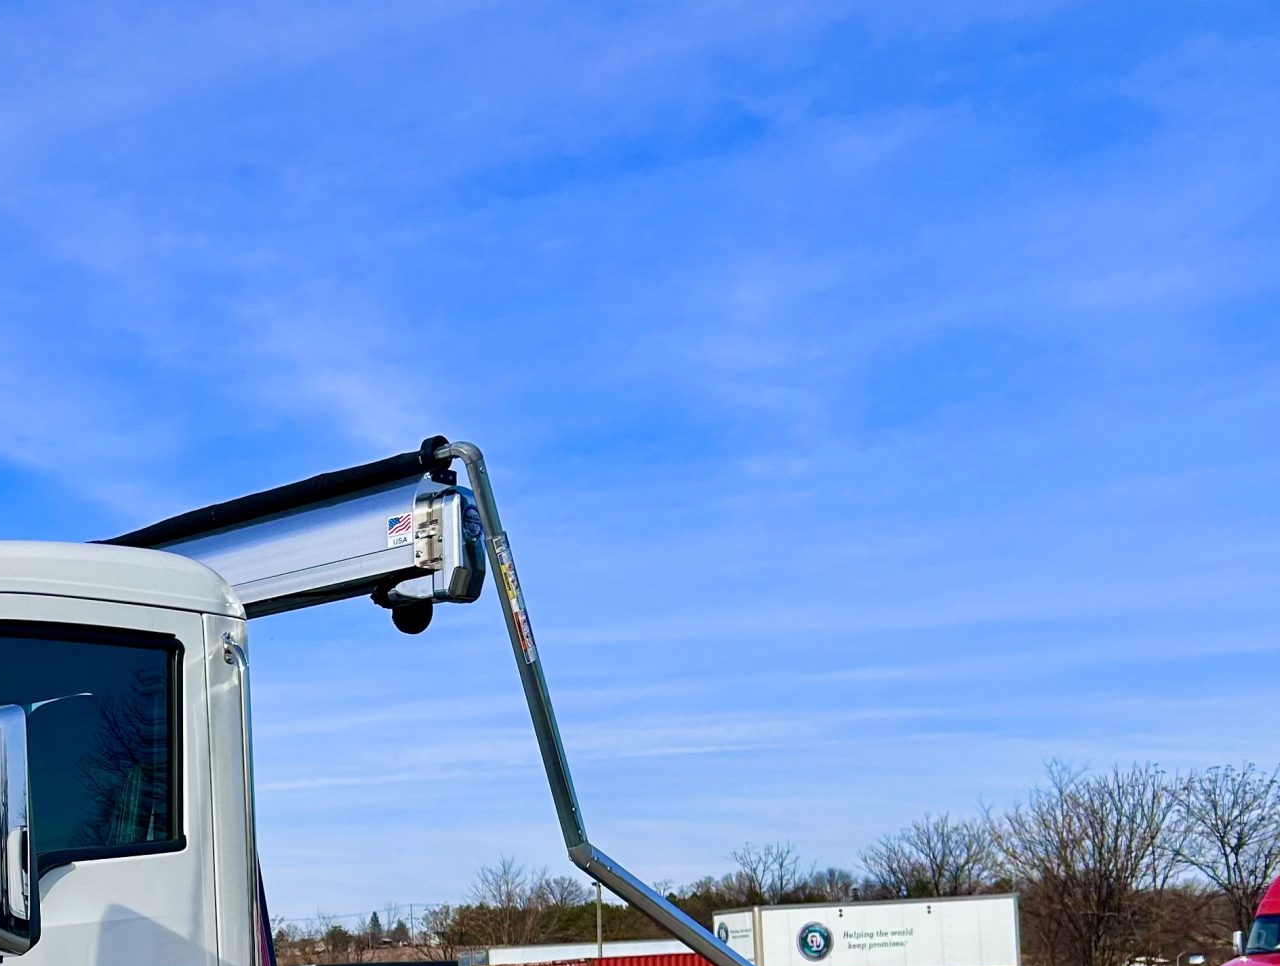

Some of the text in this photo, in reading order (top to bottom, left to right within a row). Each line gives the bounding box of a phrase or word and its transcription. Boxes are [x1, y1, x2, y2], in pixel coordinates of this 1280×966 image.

[393, 537, 408, 545] USA
[843, 927, 913, 940] Helping the world
[848, 941, 866, 950] keep
